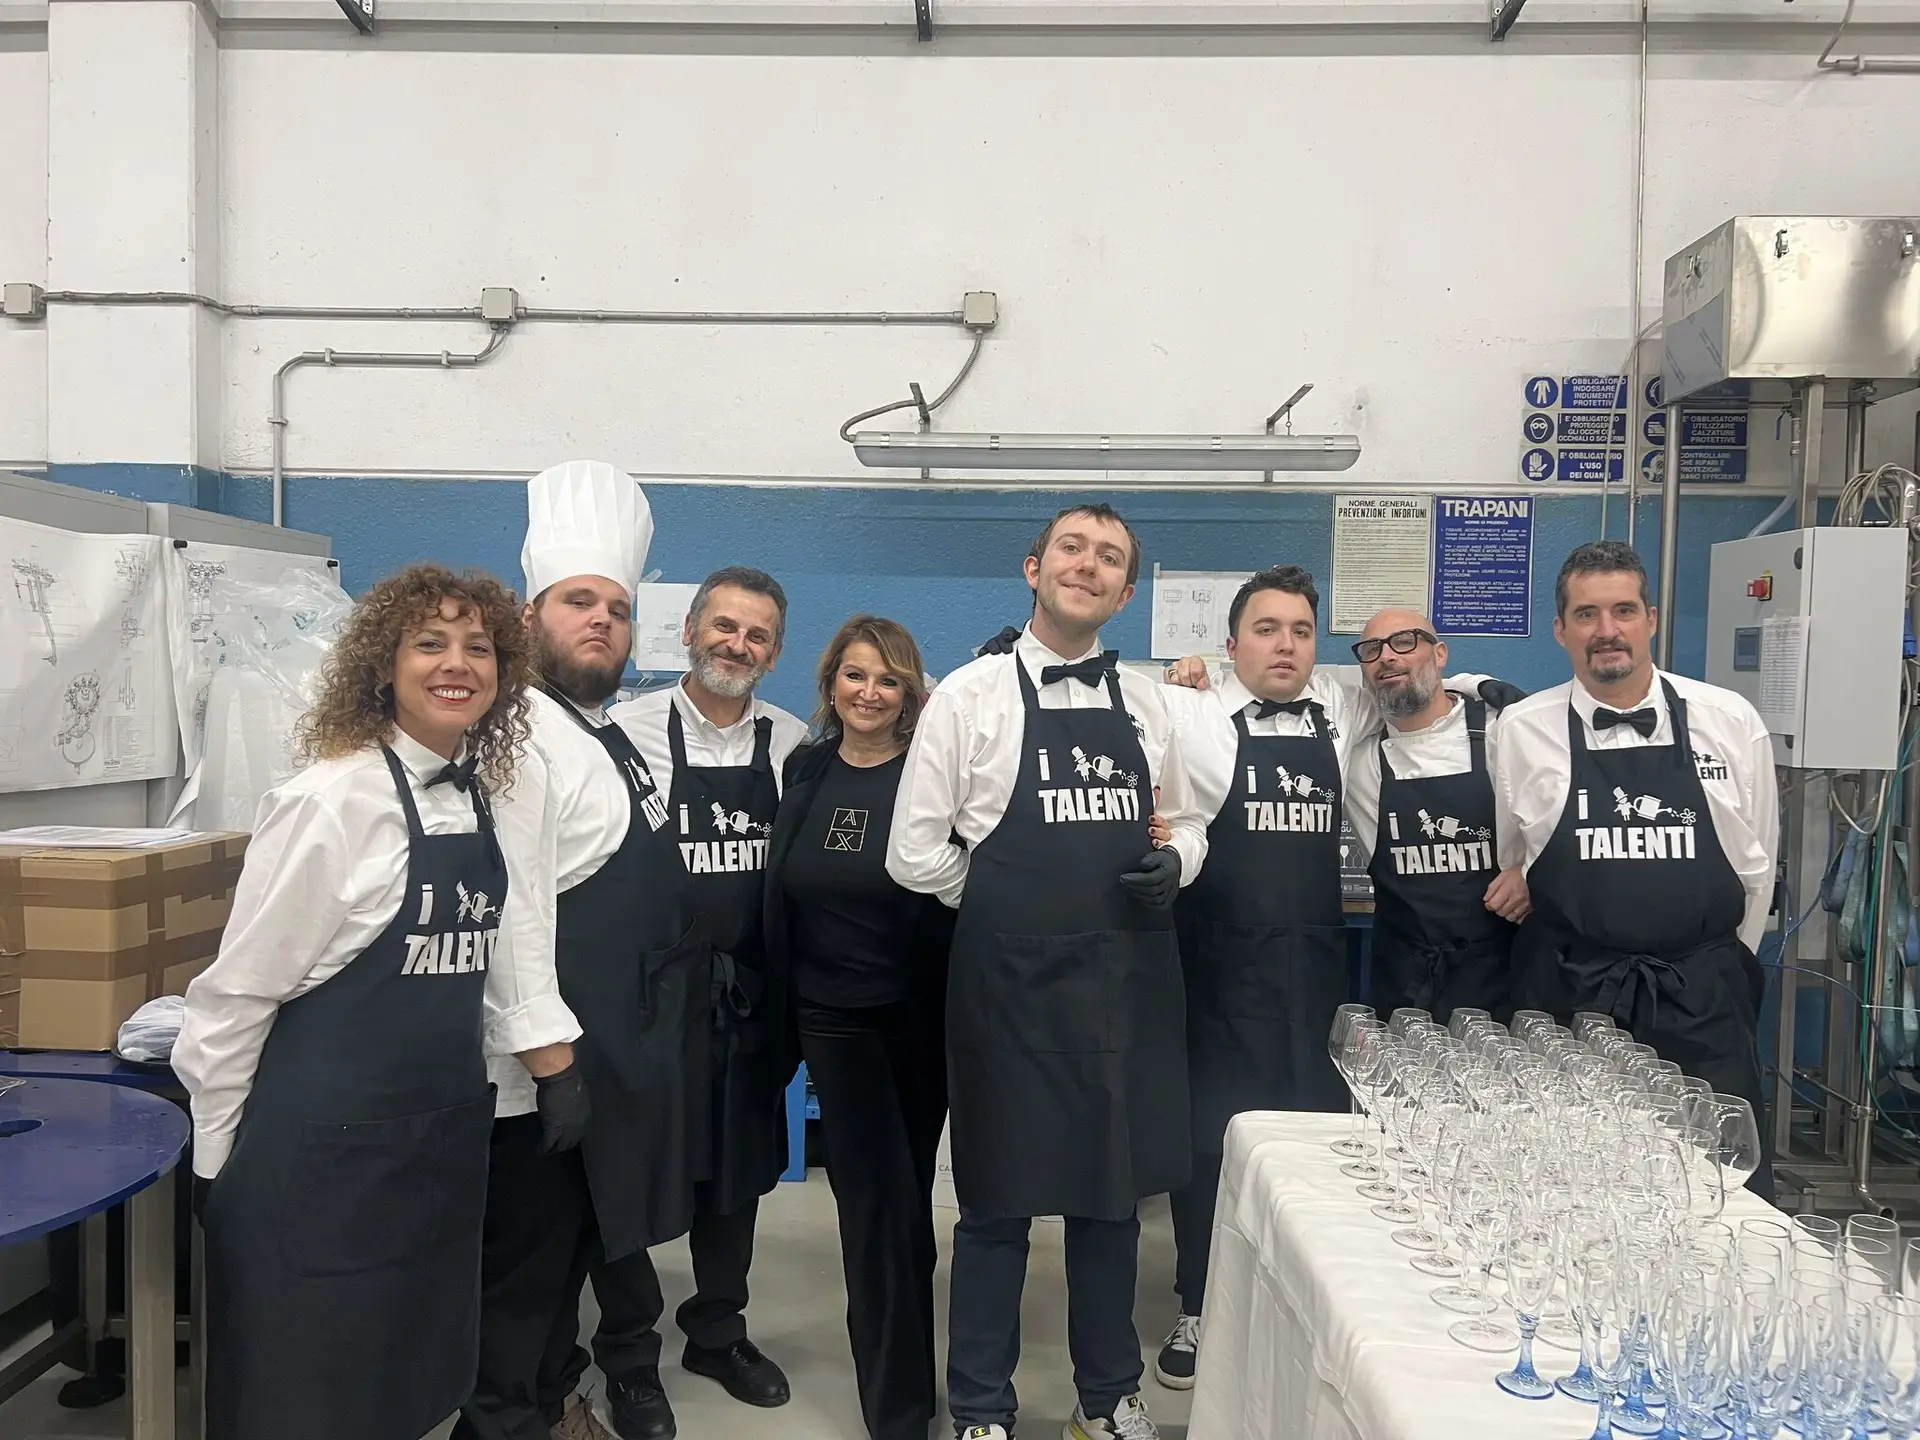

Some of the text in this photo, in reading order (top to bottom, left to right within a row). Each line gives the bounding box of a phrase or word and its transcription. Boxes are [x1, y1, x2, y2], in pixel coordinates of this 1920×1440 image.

[1569, 452, 1622, 460] OBBLIGATRIO
[1338, 507, 1427, 519] PREVENZIONE INFORTUNI
[1379, 500, 1418, 508] GENERALI
[1441, 500, 1528, 518] TRAPANI
[1038, 748, 1051, 781] i
[1247, 765, 1257, 794] i
[1697, 766, 1728, 780] ENTI
[679, 804, 689, 834] i
[1038, 787, 1139, 823] TALENTI
[1244, 801, 1332, 833] TALENTI
[1578, 788, 1589, 820] i
[1389, 812, 1400, 840] i
[678, 839, 771, 874] TALENTI
[1390, 841, 1492, 875] TALENTI
[1574, 825, 1696, 860] TALENTI
[417, 884, 434, 925] i
[400, 928, 499, 975] TALENT
